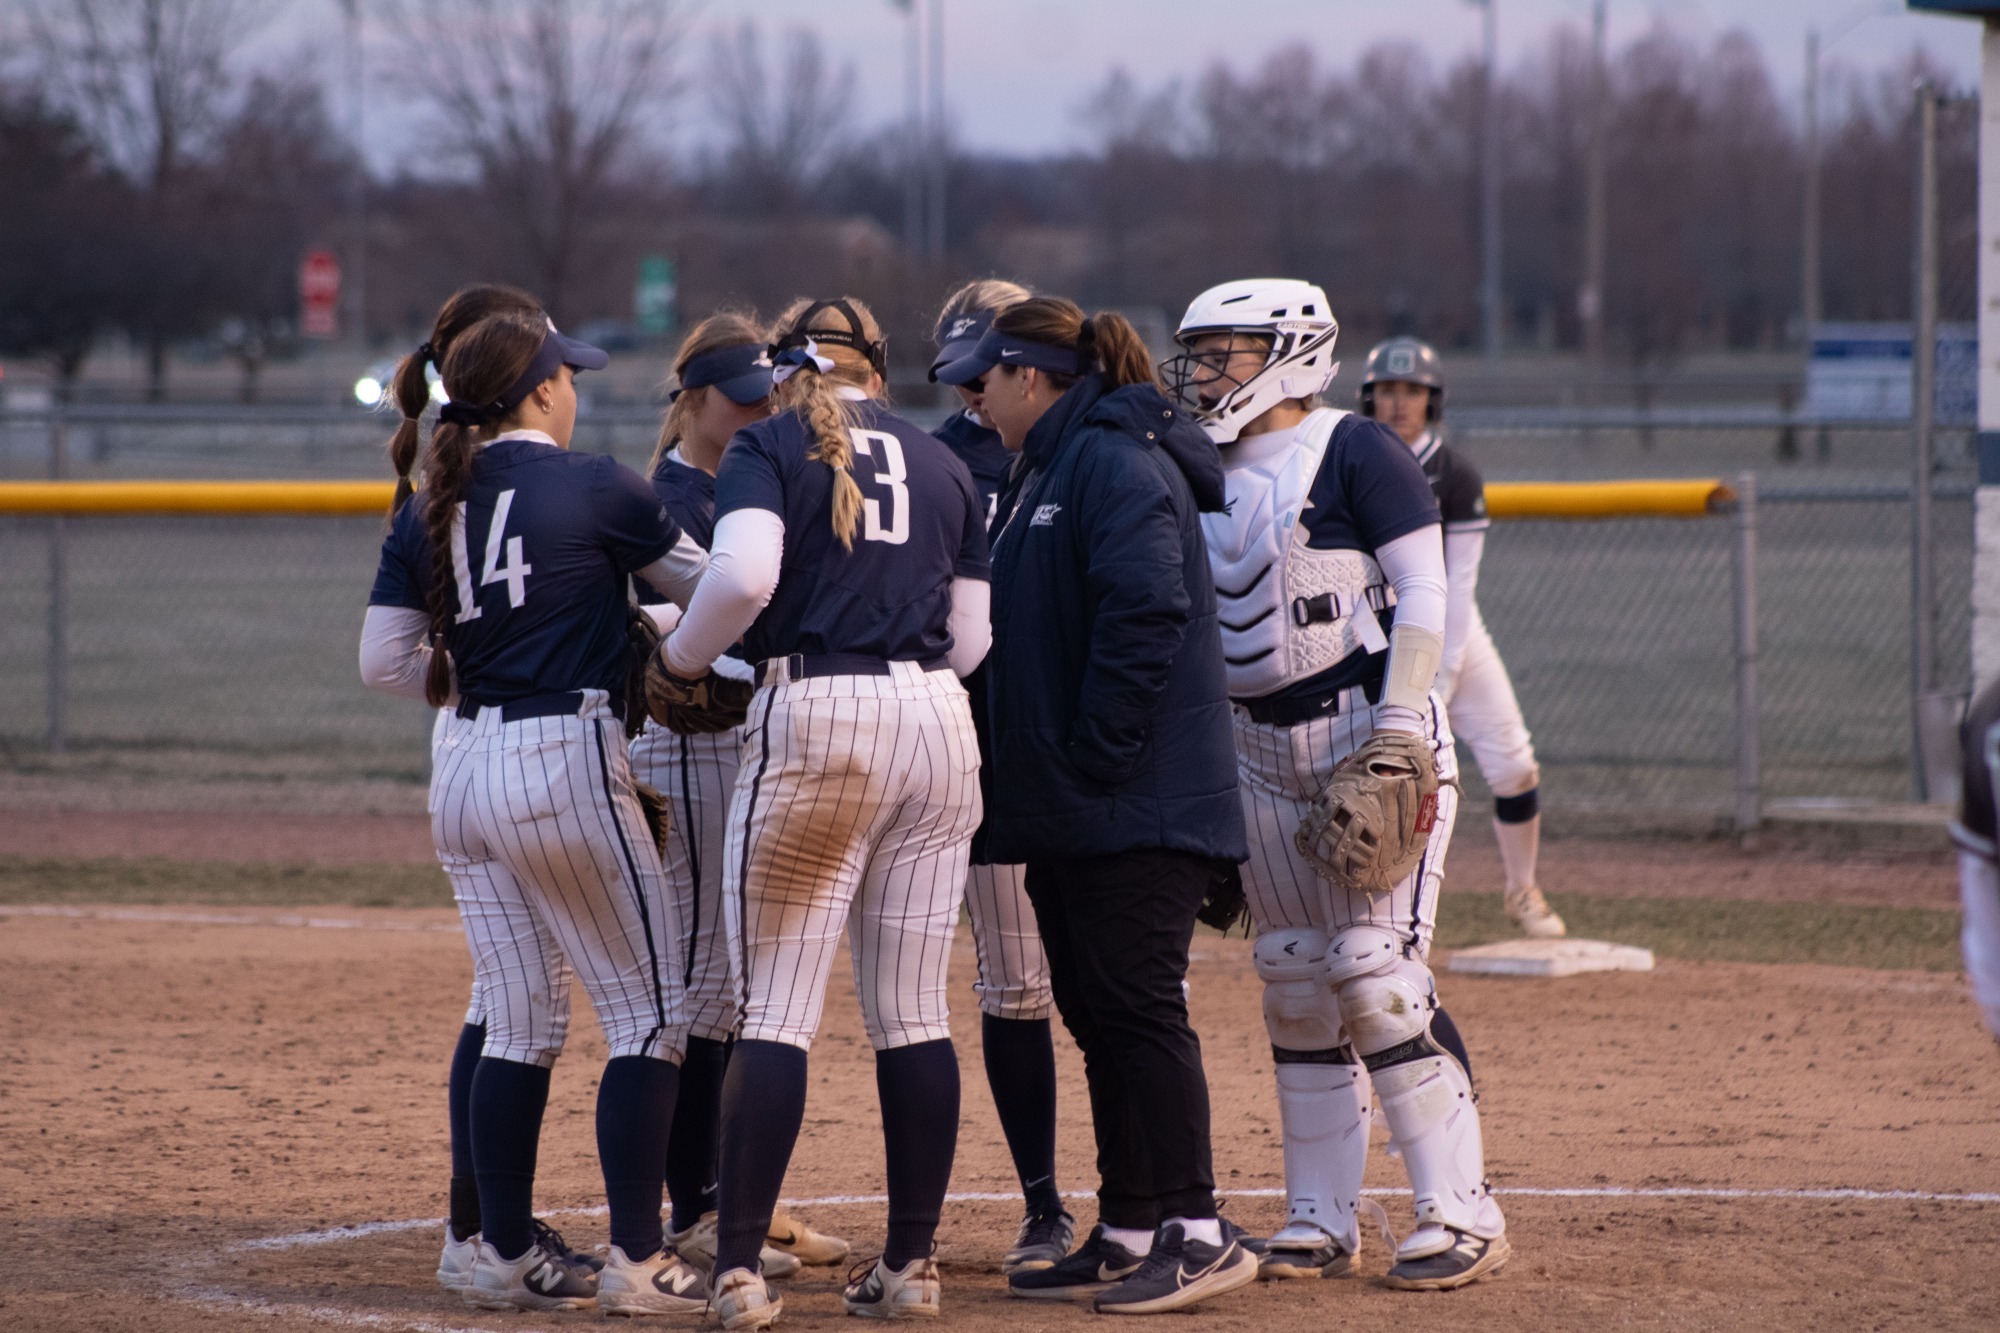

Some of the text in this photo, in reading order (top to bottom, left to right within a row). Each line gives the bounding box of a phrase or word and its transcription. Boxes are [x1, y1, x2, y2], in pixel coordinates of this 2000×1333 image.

[1276, 322, 1310, 330] EASTON
[849, 428, 910, 545] 3
[450, 489, 532, 625] 14
[530, 1262, 565, 1293] N
[659, 1265, 699, 1295] N
